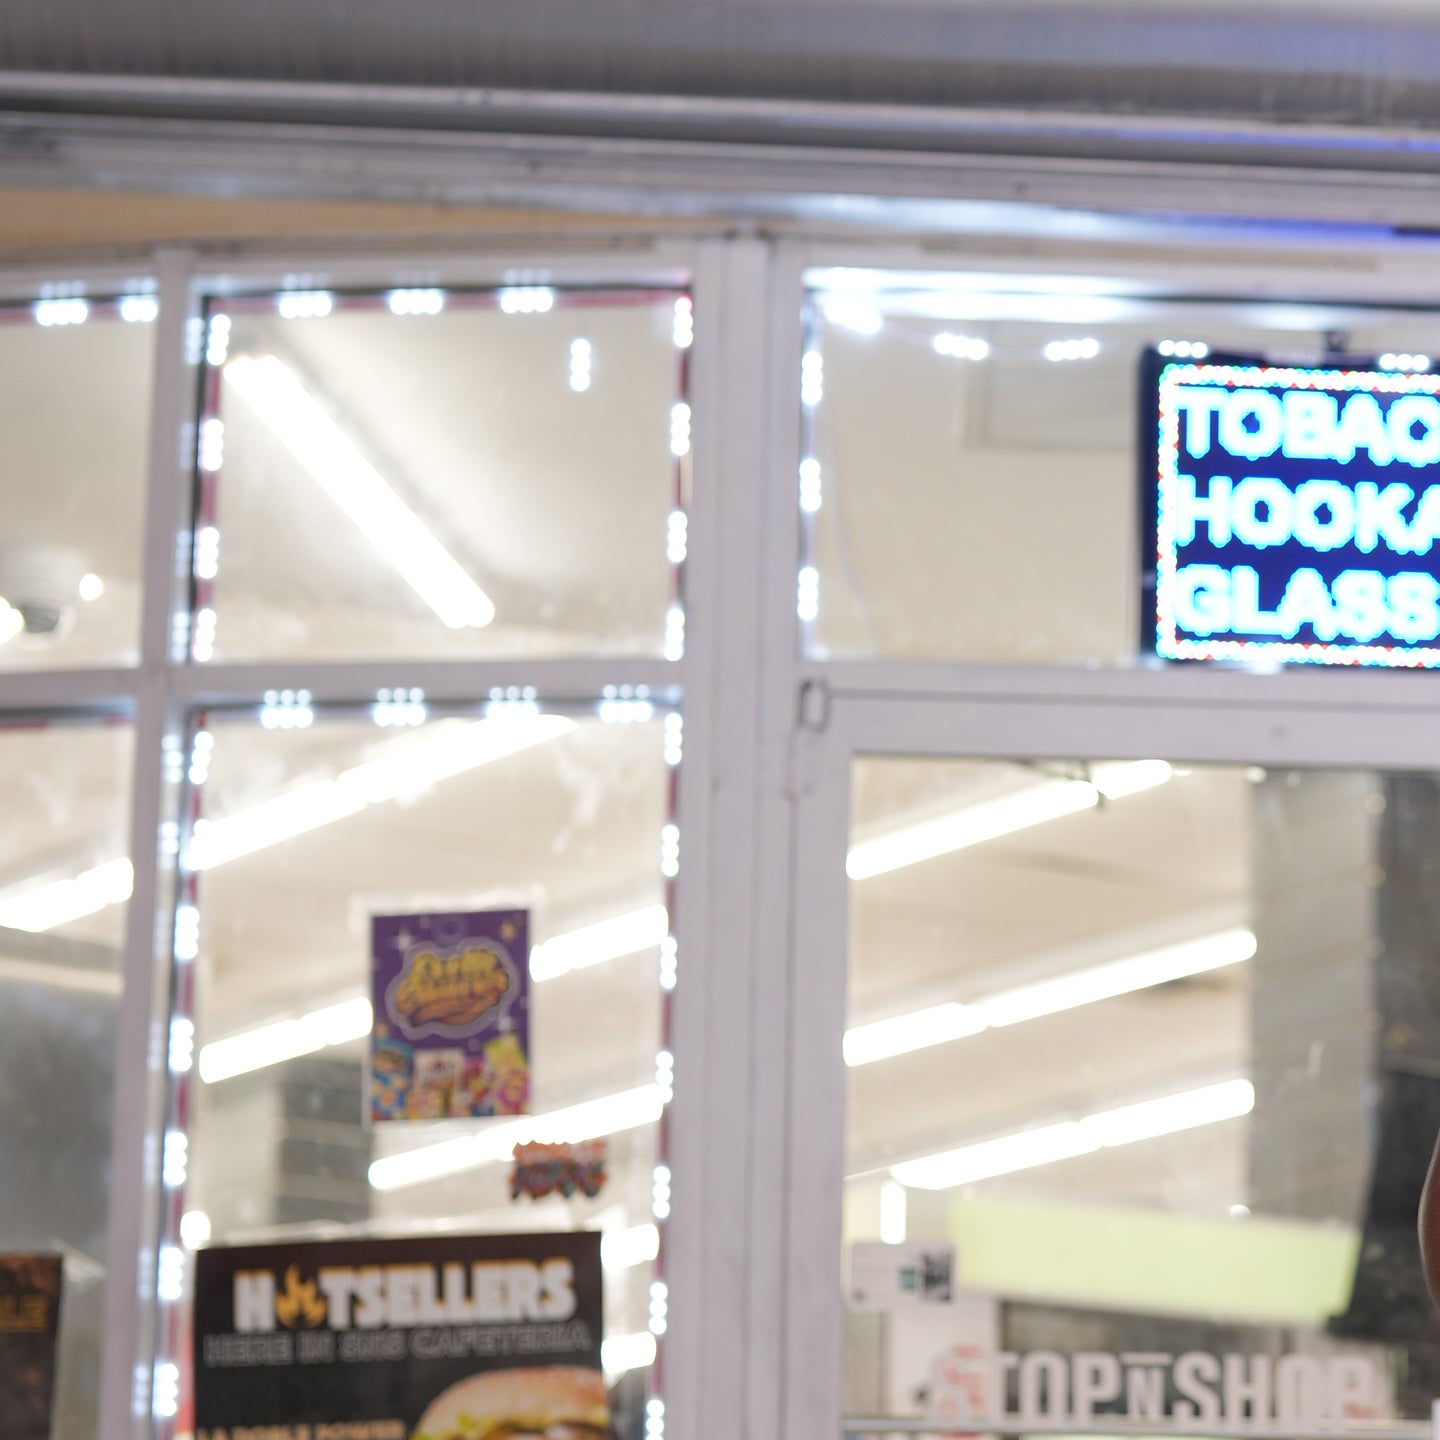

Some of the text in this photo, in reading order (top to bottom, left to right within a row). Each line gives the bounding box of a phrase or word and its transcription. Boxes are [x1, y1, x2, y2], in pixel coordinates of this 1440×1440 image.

[205, 1333, 294, 1367] HERE
[296, 1330, 335, 1363] IN
[409, 1318, 592, 1358] CAFETERIA
